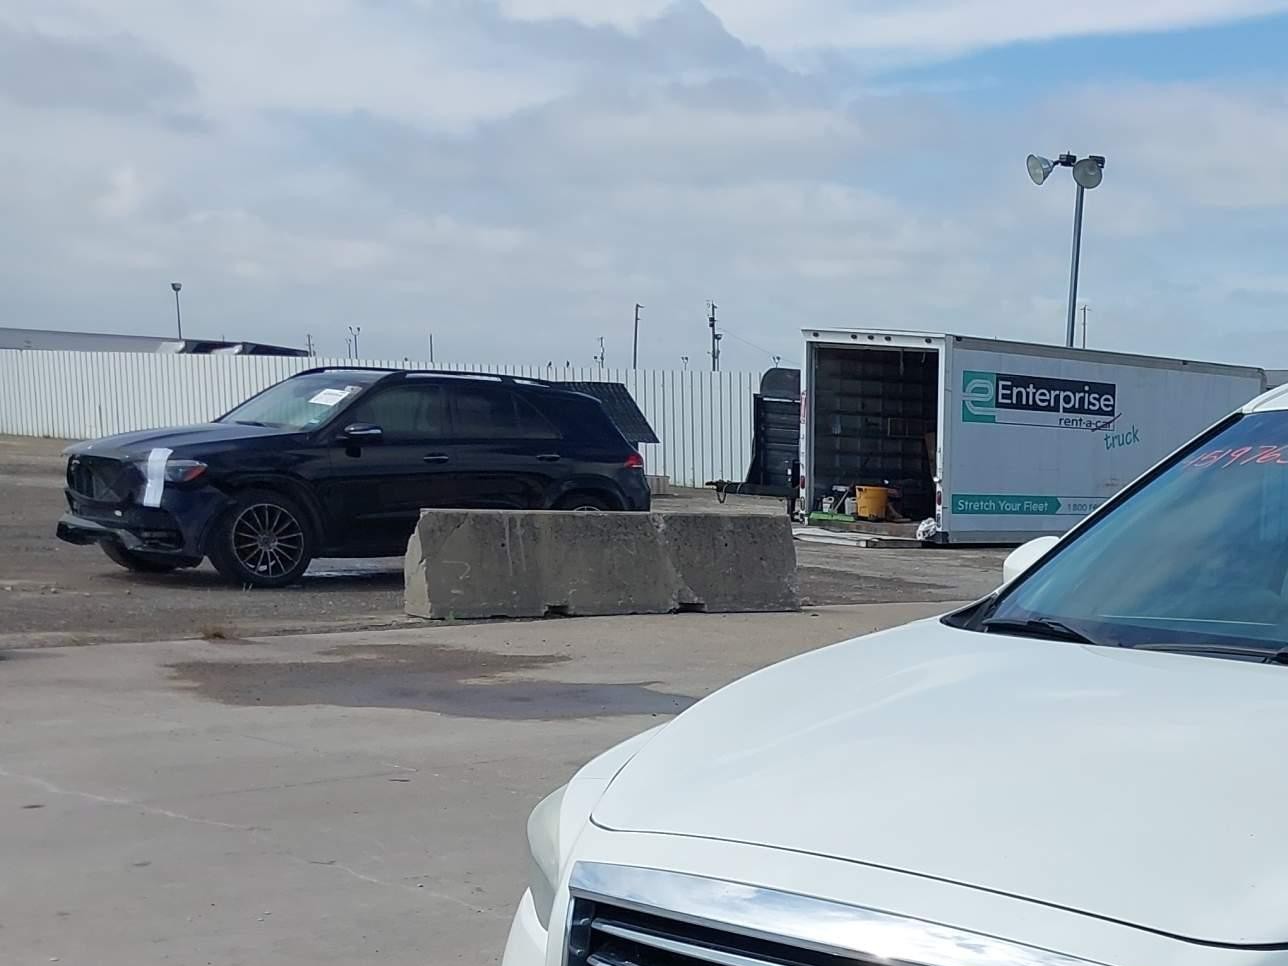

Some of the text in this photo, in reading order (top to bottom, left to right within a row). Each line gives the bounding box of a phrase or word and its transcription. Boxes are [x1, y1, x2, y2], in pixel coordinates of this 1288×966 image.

[998, 381, 1114, 413] Enterprise
[1104, 424, 1140, 450] truck
[958, 499, 1048, 512] Stretch Your Fleet
